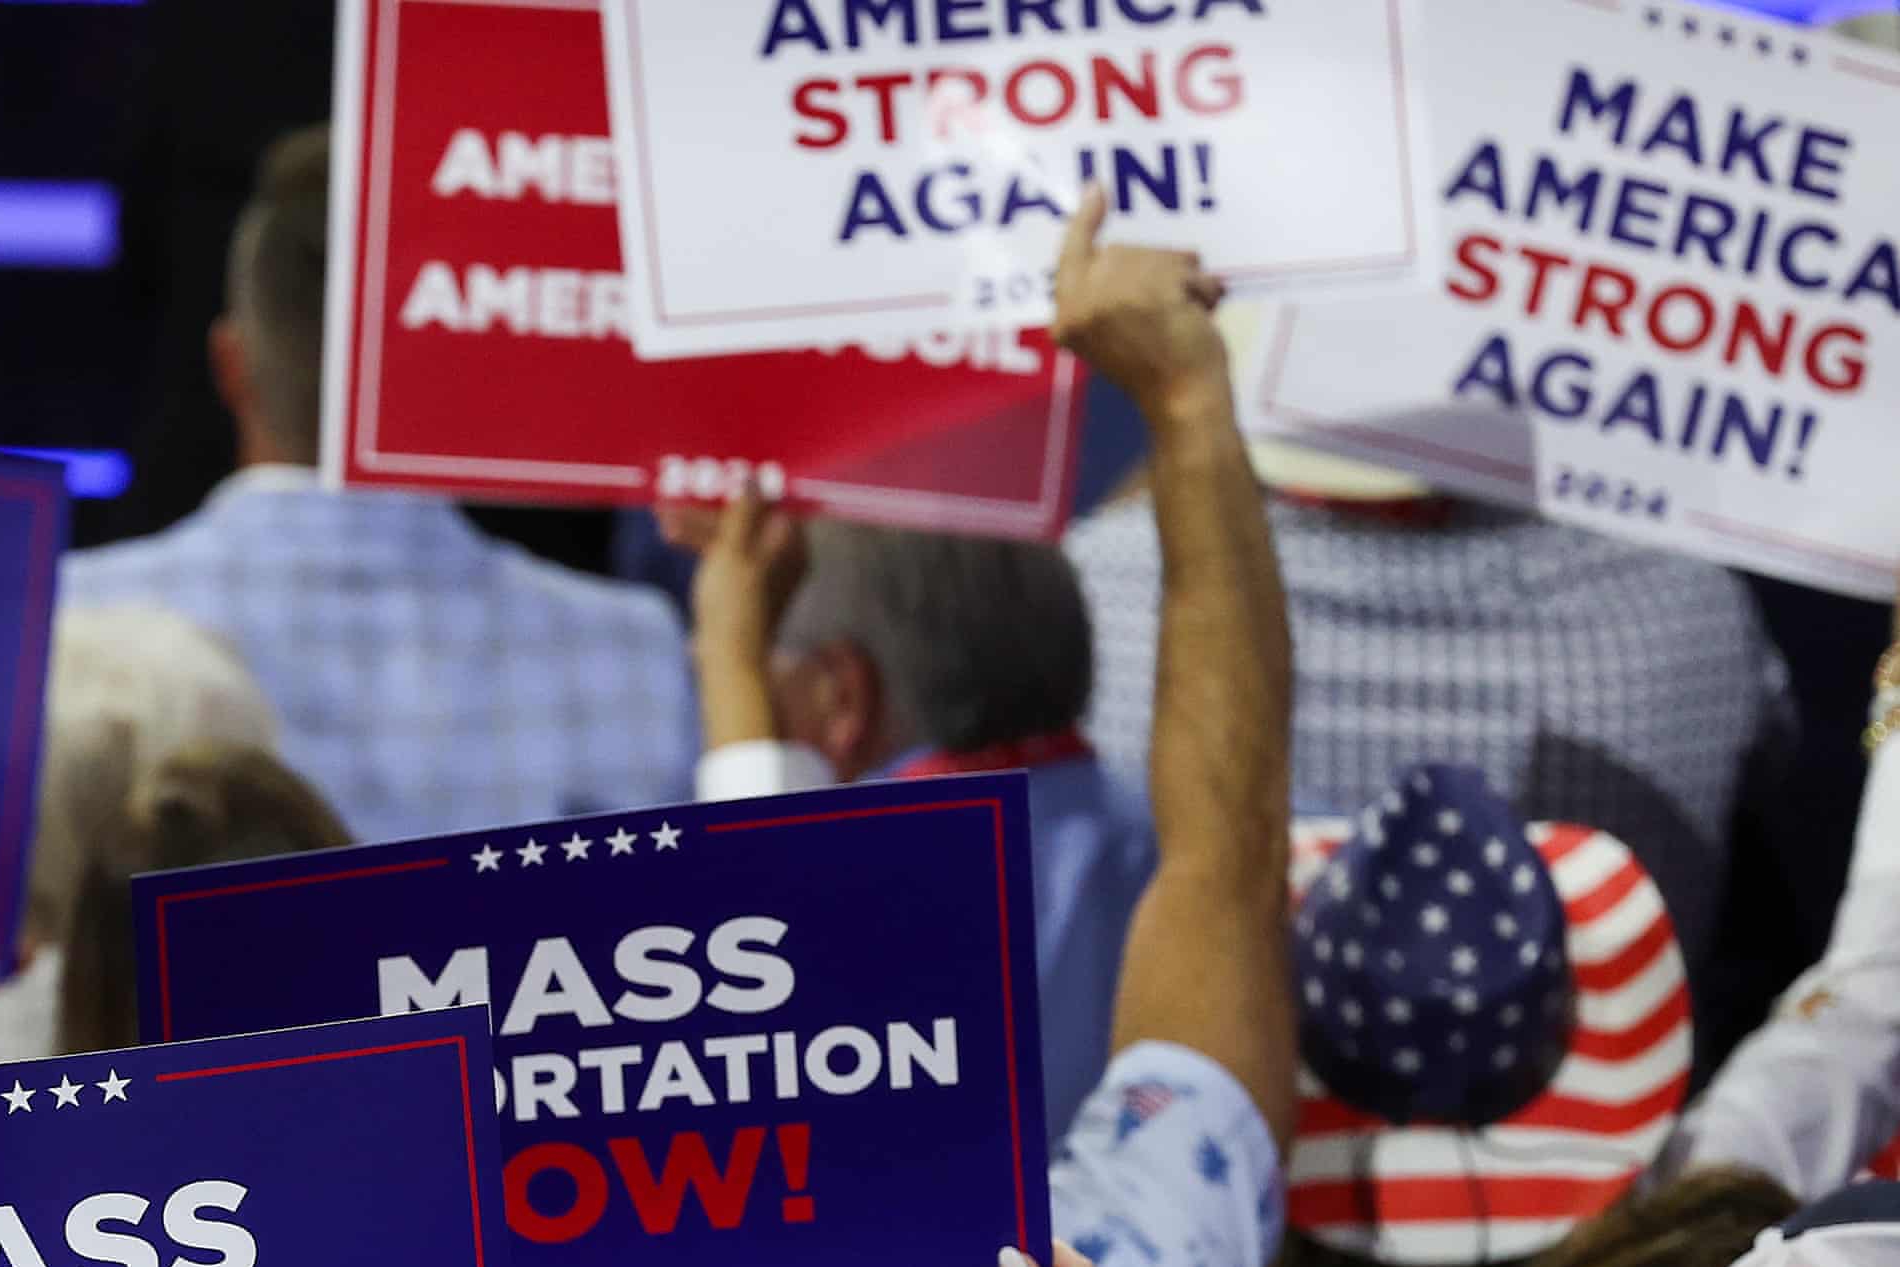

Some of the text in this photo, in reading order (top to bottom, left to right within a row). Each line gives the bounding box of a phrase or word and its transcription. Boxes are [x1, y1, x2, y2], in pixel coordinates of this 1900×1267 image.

[790, 44, 1245, 149] STRONG
[1558, 66, 1852, 204] MAKE
[839, 142, 1216, 241] AGAIN!
[1443, 140, 1900, 315] AMERICA
[1445, 233, 1869, 392] STRONG
[1453, 333, 1819, 479] AGAIN!
[378, 916, 796, 1034] MASS
[502, 1123, 815, 1244] OW!
